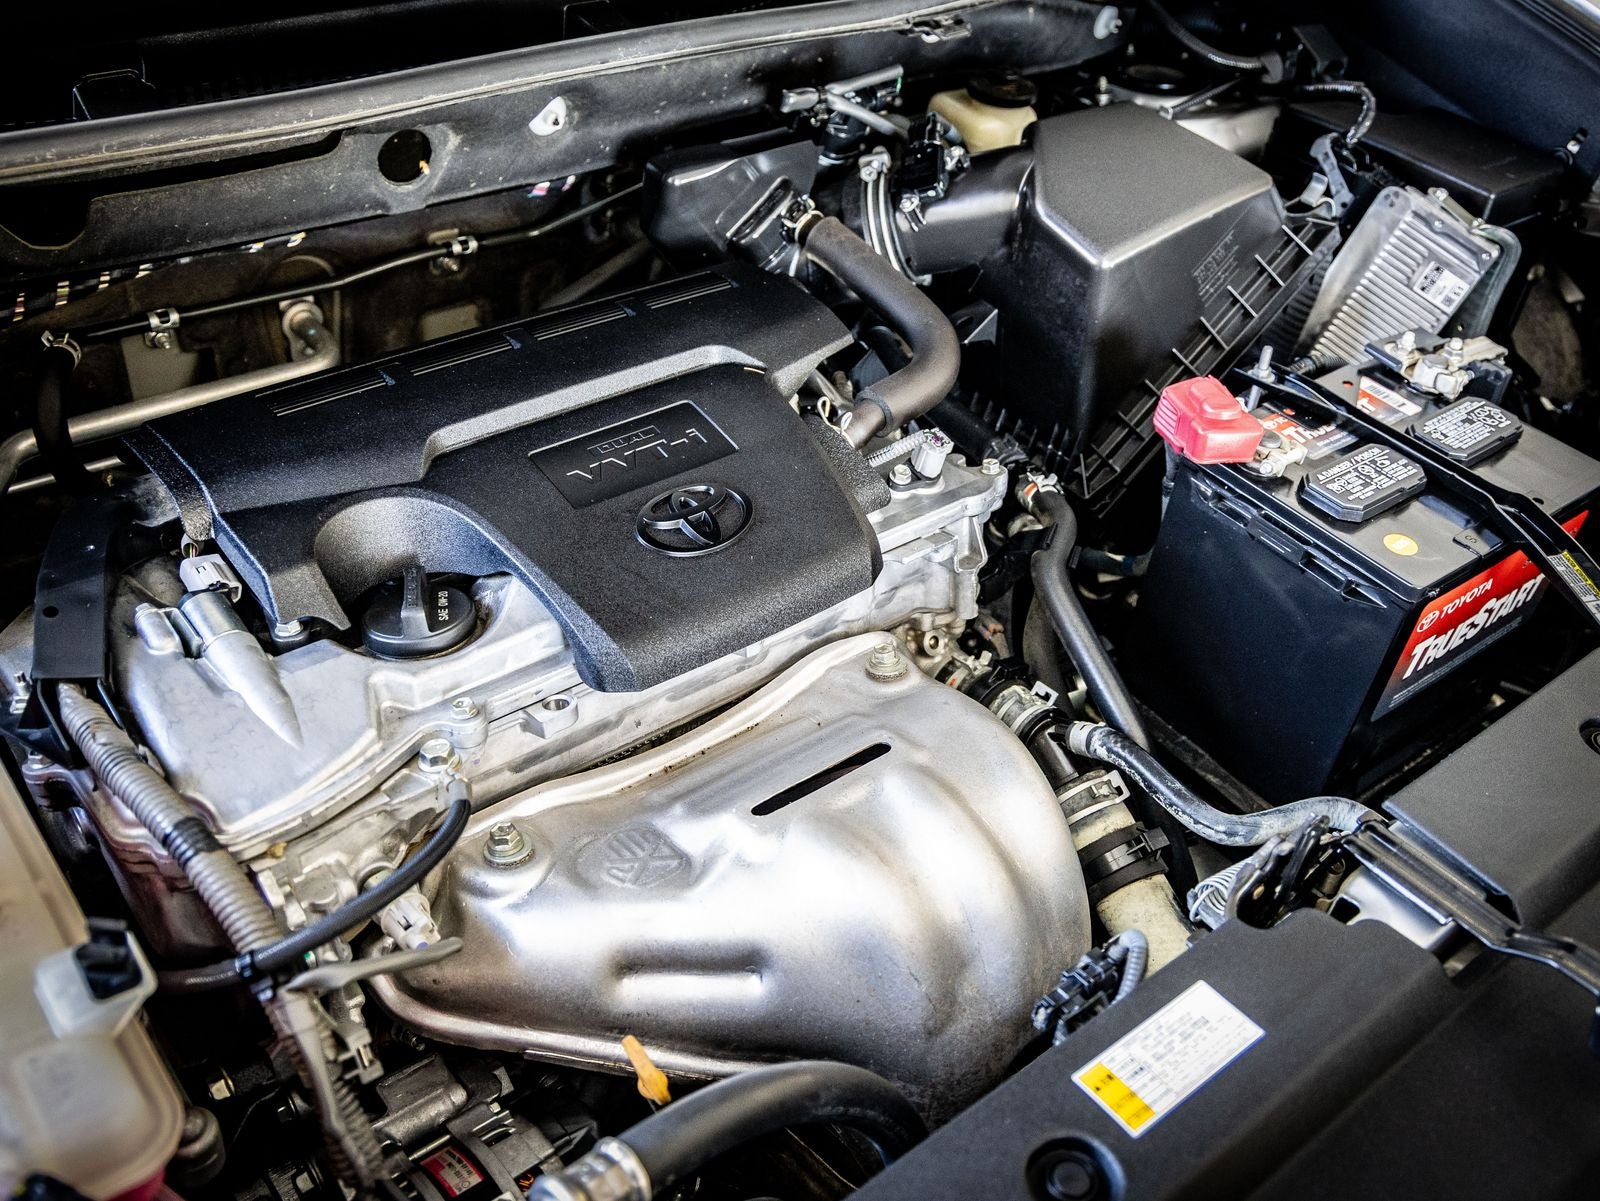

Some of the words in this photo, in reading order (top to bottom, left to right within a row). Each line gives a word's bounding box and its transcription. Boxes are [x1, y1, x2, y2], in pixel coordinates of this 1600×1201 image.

[596, 431, 656, 454] DUAL
[1322, 460, 1354, 478] DANGER
[1354, 447, 1382, 463] POISON
[438, 590, 449, 607] 0W-20
[1441, 578, 1494, 618] TOYOTA
[438, 609, 449, 621] SAE
